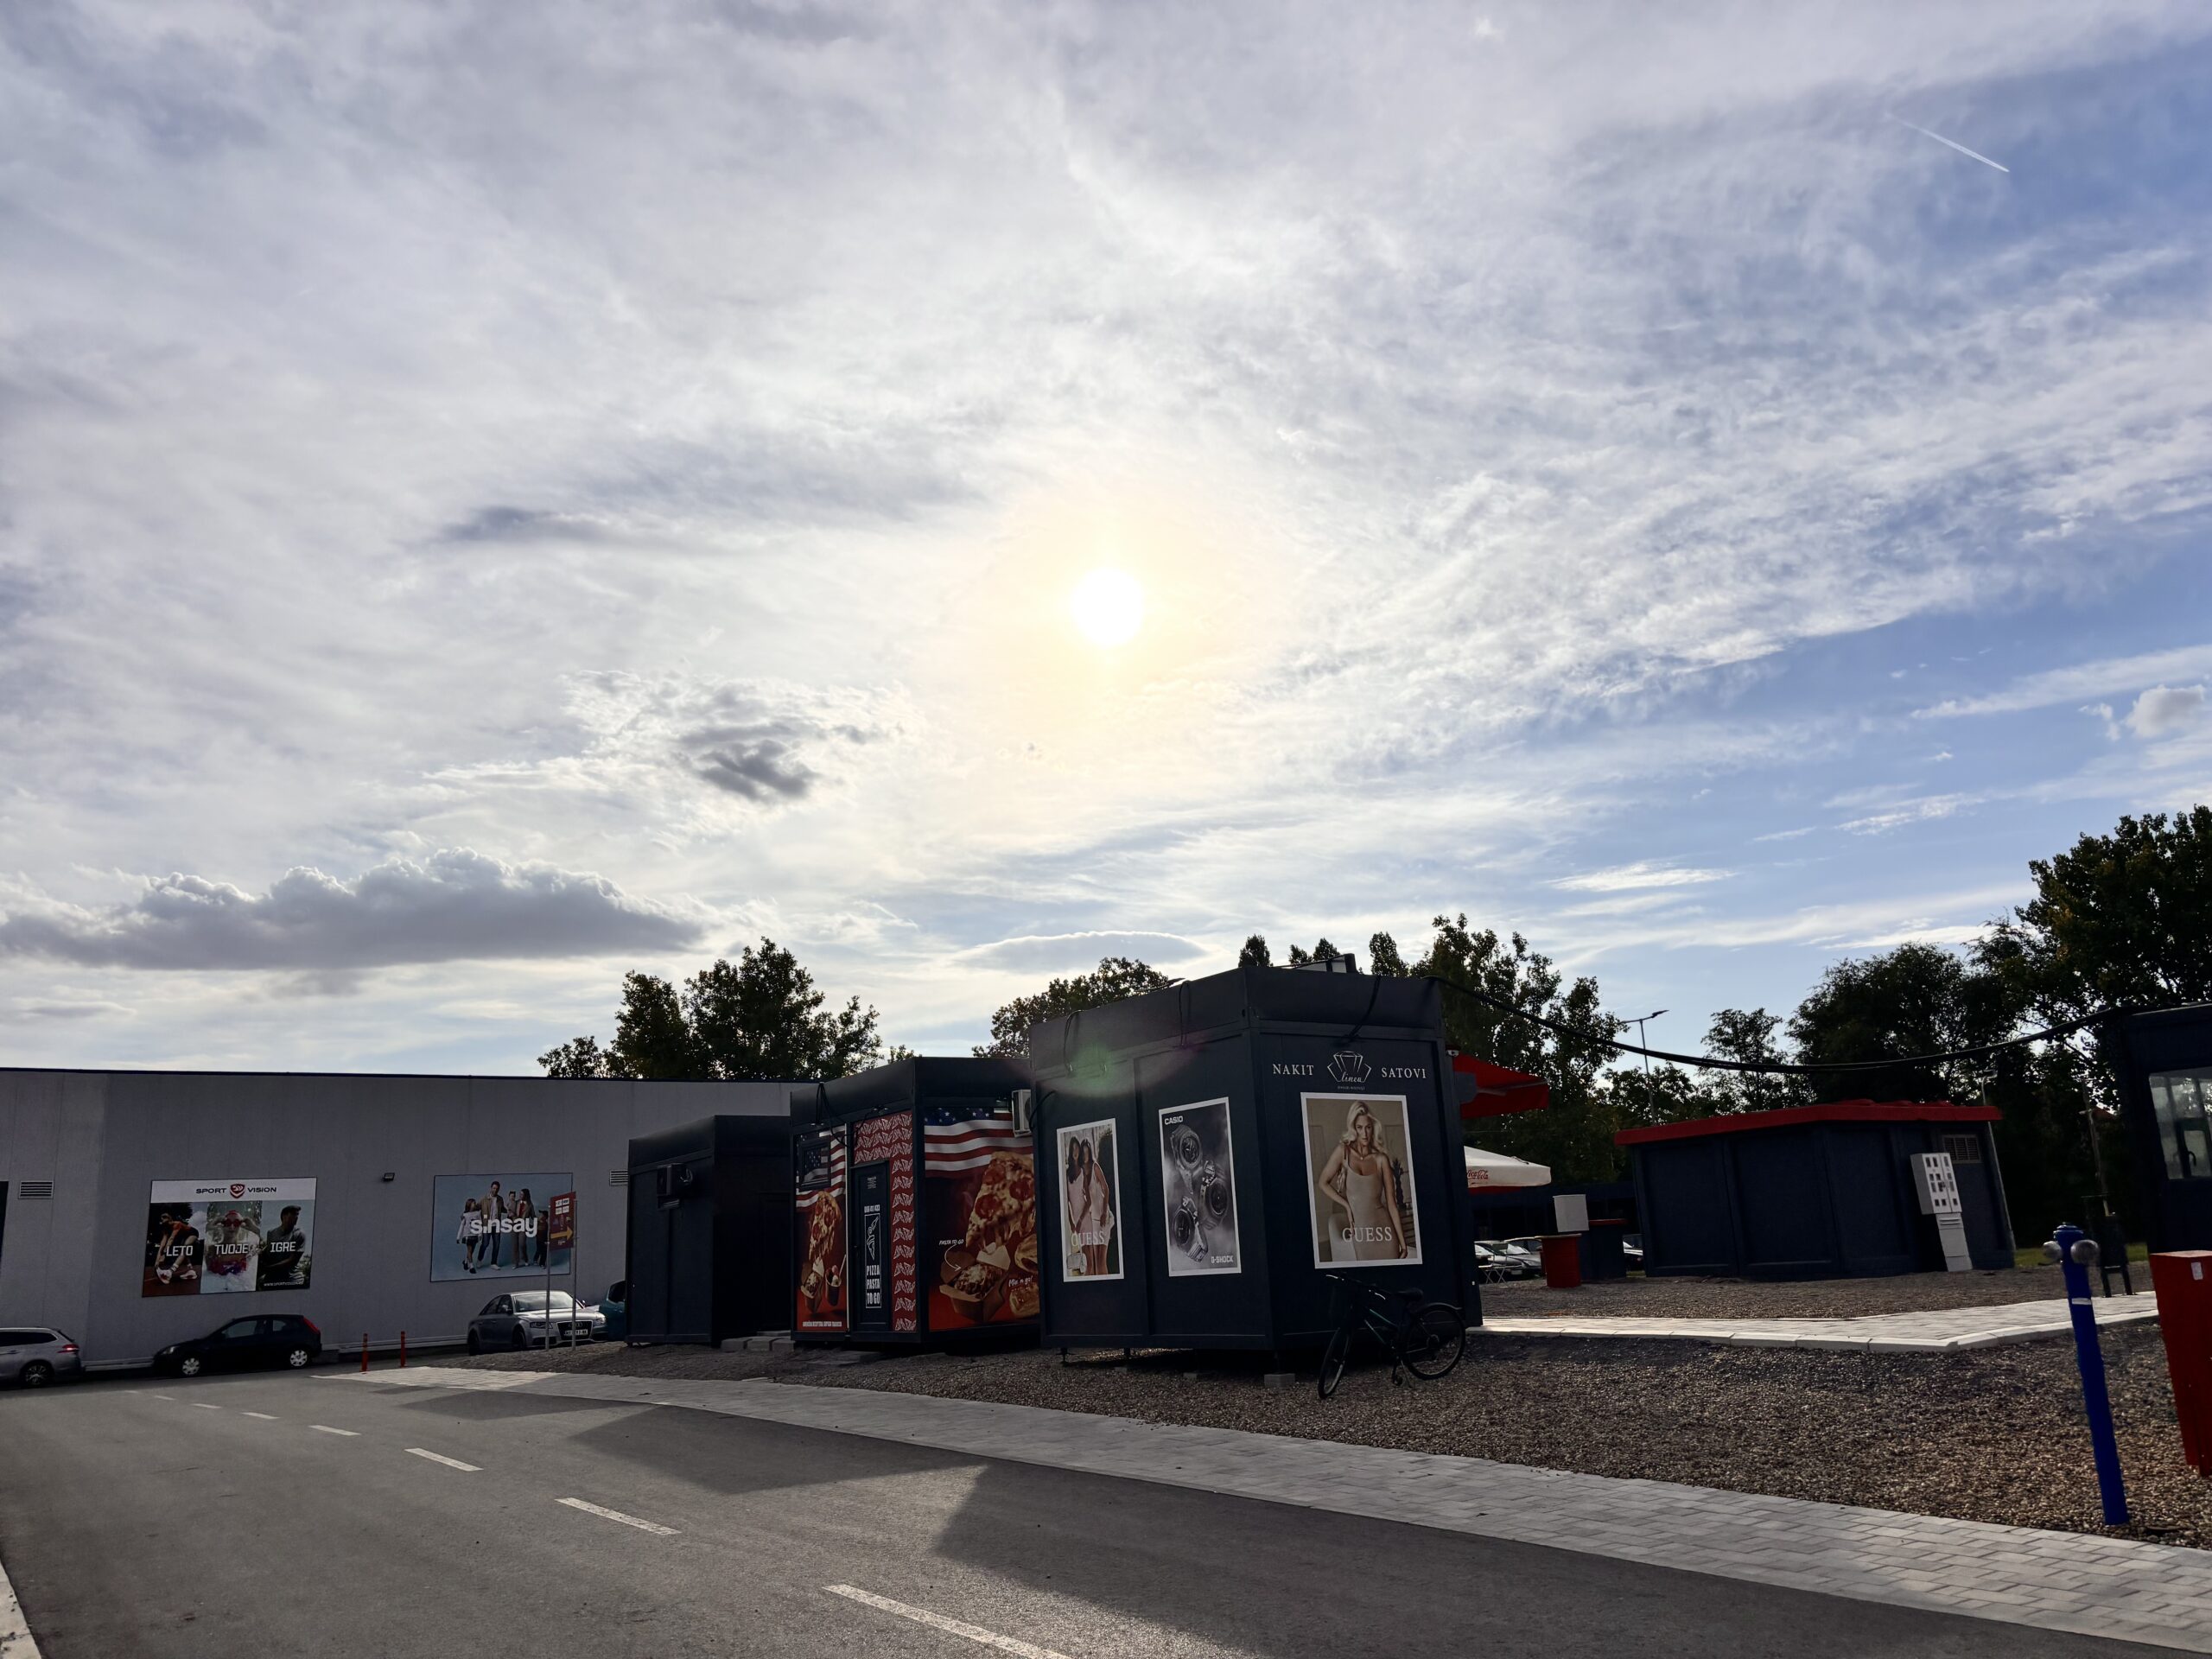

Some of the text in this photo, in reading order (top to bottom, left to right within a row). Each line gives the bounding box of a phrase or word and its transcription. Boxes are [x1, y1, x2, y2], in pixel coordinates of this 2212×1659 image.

[1272, 1064, 1427, 1079] NAKIT SATOVI
[1164, 1116, 1184, 1125] CASIO
[470, 1214, 538, 1237] sinsay
[1071, 1231, 1104, 1247] GUESS
[1342, 1226, 1393, 1243] GUESS
[165, 1245, 194, 1257] LETO
[270, 1241, 296, 1253] IGRE
[1211, 1255, 1234, 1264] G-SHOCK
[866, 1264, 880, 1276] PIZZA
[866, 1278, 880, 1290] PASTA
[867, 1292, 880, 1305] TO GO
